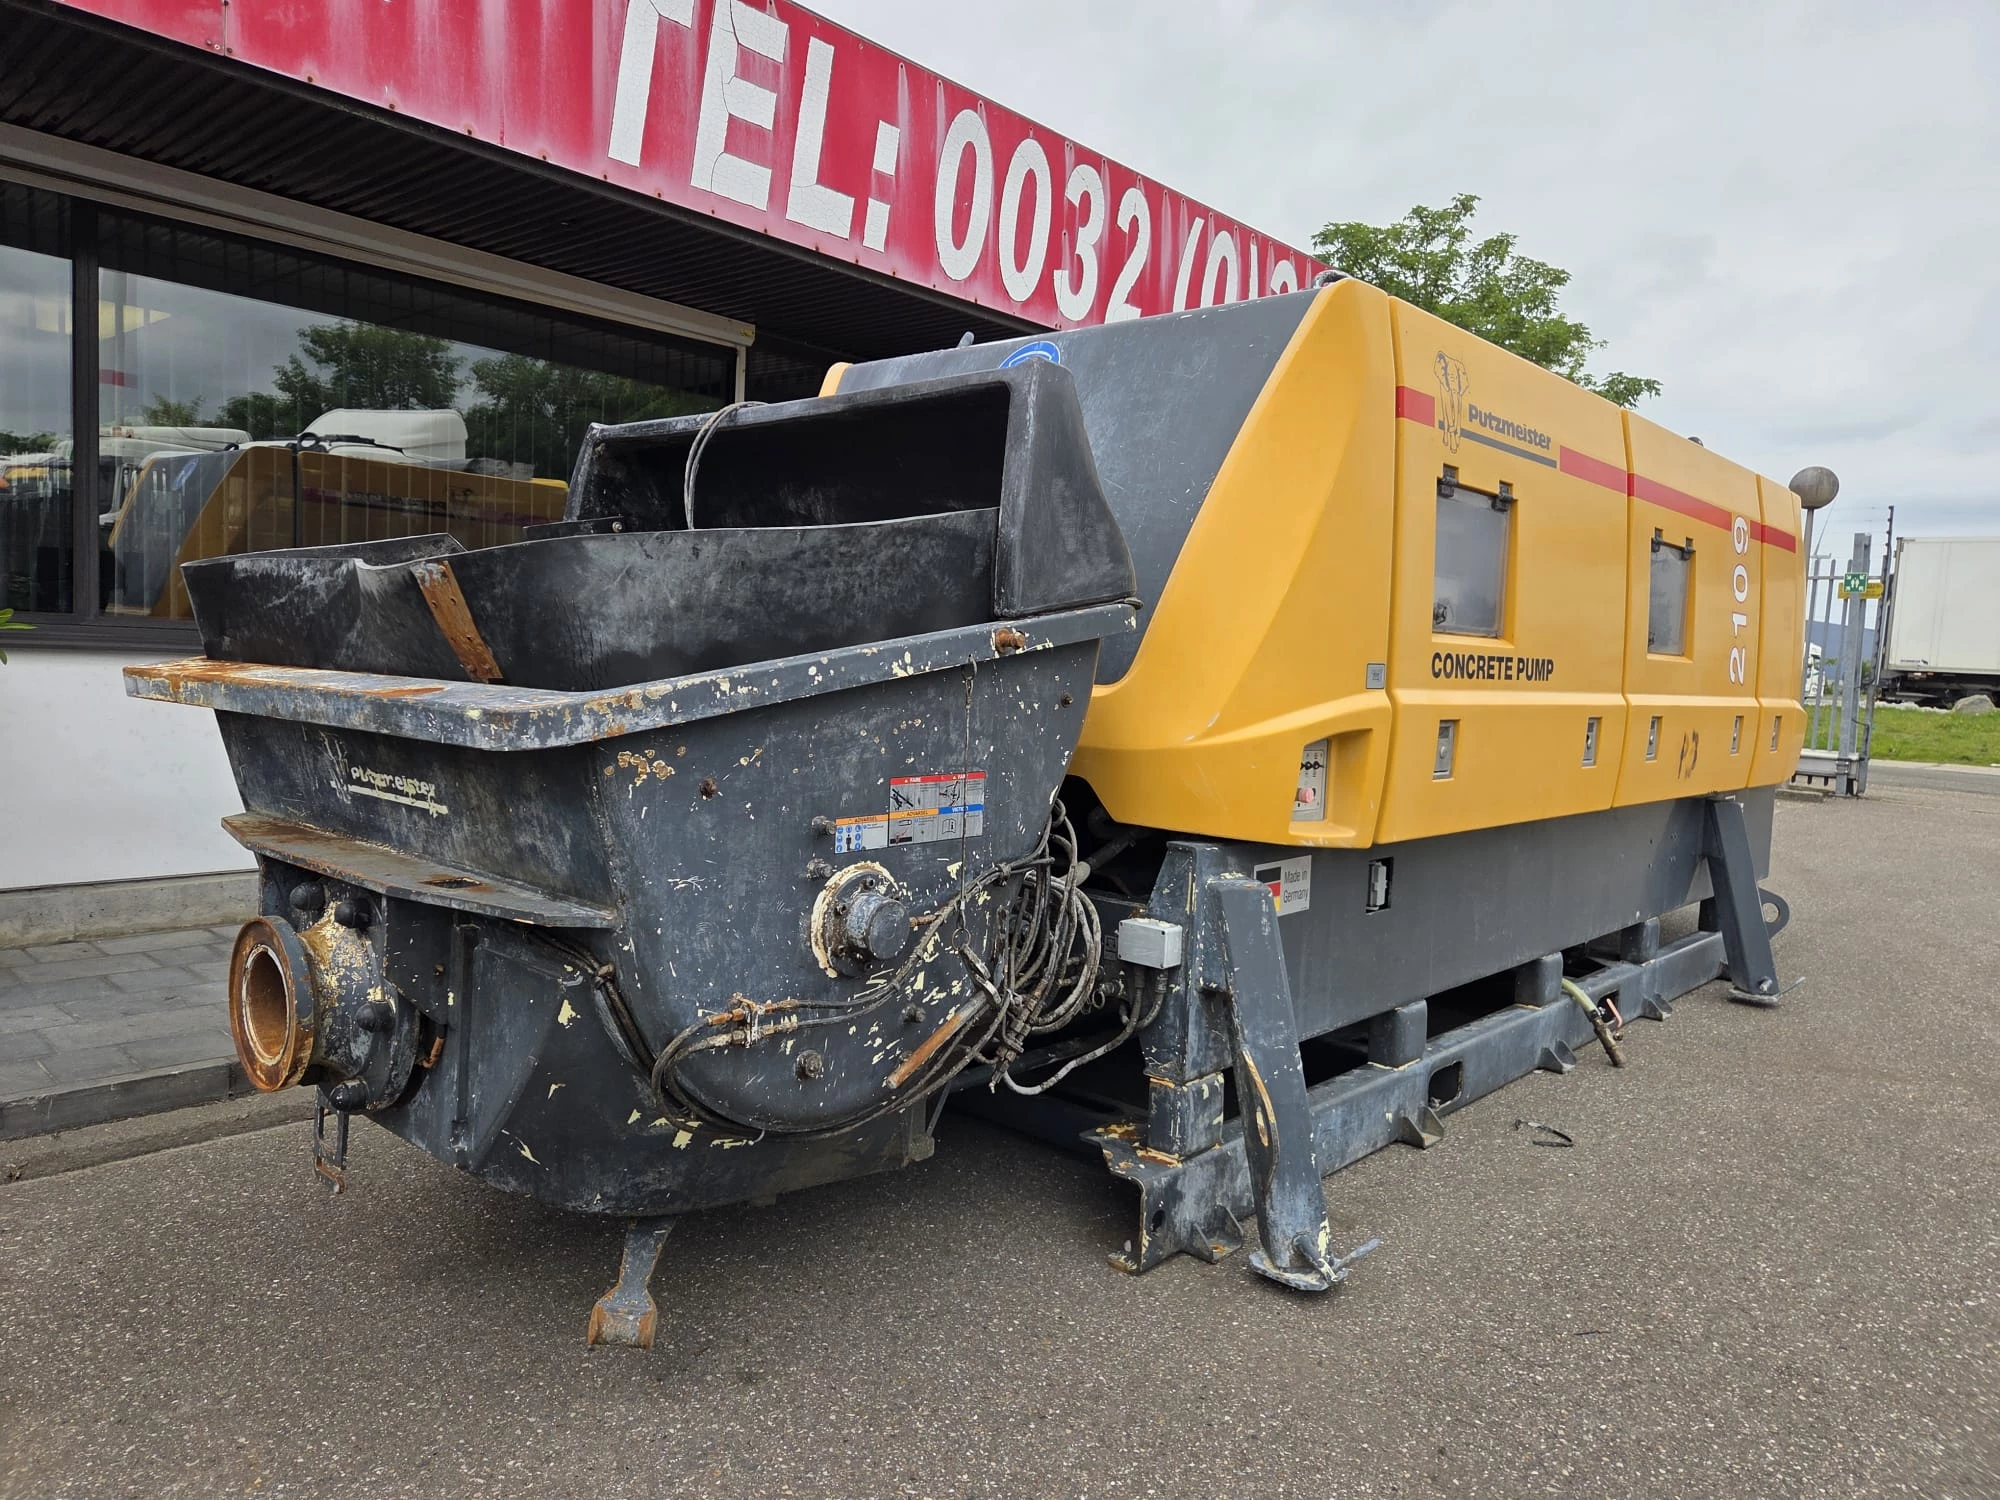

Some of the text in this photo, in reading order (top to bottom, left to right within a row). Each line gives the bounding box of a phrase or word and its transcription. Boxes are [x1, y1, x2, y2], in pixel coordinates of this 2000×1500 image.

[935, 109, 1151, 324] 0032
[1468, 403, 1552, 451] Putzmeister
[1729, 515, 1749, 686] 2109
[1431, 652, 1554, 681] CONCRETE PUMP
[1283, 888, 1309, 903] Germany
[1284, 869, 1308, 884] Made in
